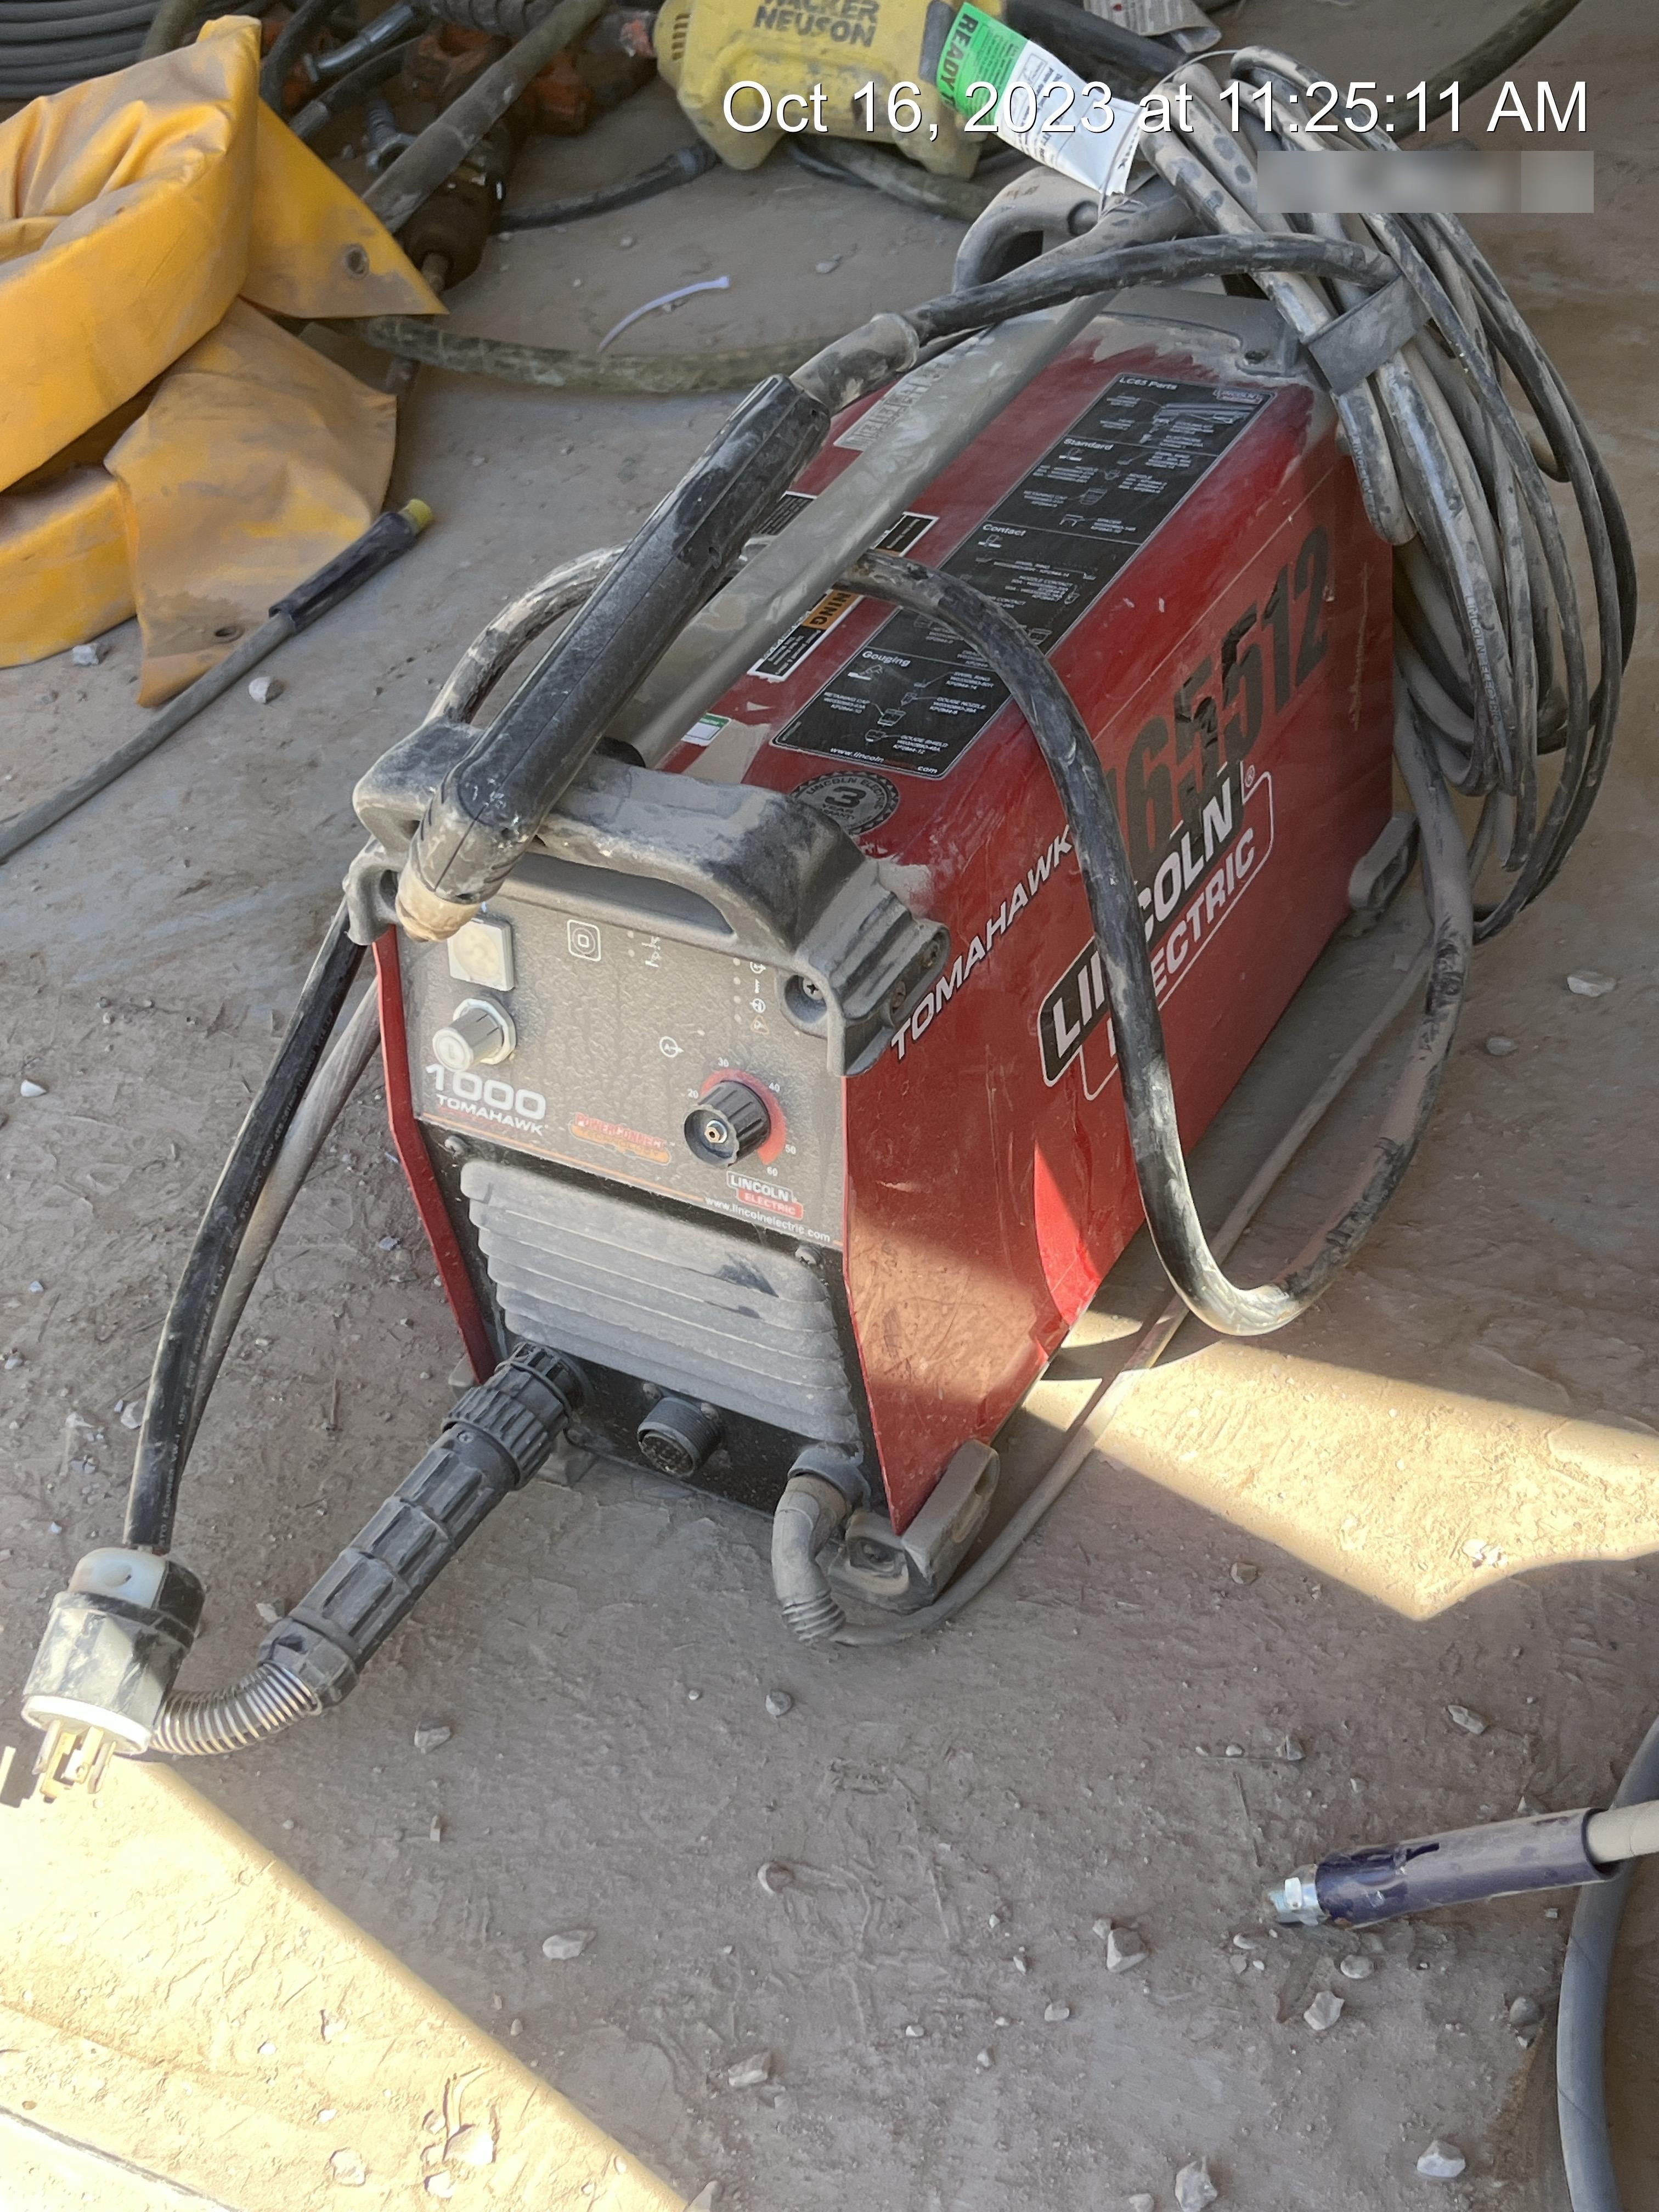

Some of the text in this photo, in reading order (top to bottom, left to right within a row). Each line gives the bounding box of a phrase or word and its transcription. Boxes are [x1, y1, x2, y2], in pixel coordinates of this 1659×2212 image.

[753, 5, 877, 47] NEUSON
[940, 13, 979, 93] READY
[1148, 381, 1178, 391] Parts
[1064, 438, 1114, 451] Standard
[983, 524, 1026, 537] Contact
[862, 651, 911, 667] Gouging
[806, 777, 884, 810] LINCOLN ELECTRIC
[825, 786, 867, 808] 3
[891, 824, 1073, 1060] TOMAHAWK
[718, 1057, 729, 1068] 30
[425, 1063, 546, 1120] 1000
[687, 1088, 699, 1098] 20
[769, 1082, 781, 1093] 40
[785, 1144, 796, 1155] 50
[767, 1166, 778, 1177] 60
[731, 1174, 789, 1202] LINCOLN
[744, 1192, 797, 1215] ELECTRIC
[705, 1197, 831, 1243] www.lincolnelectric.com
